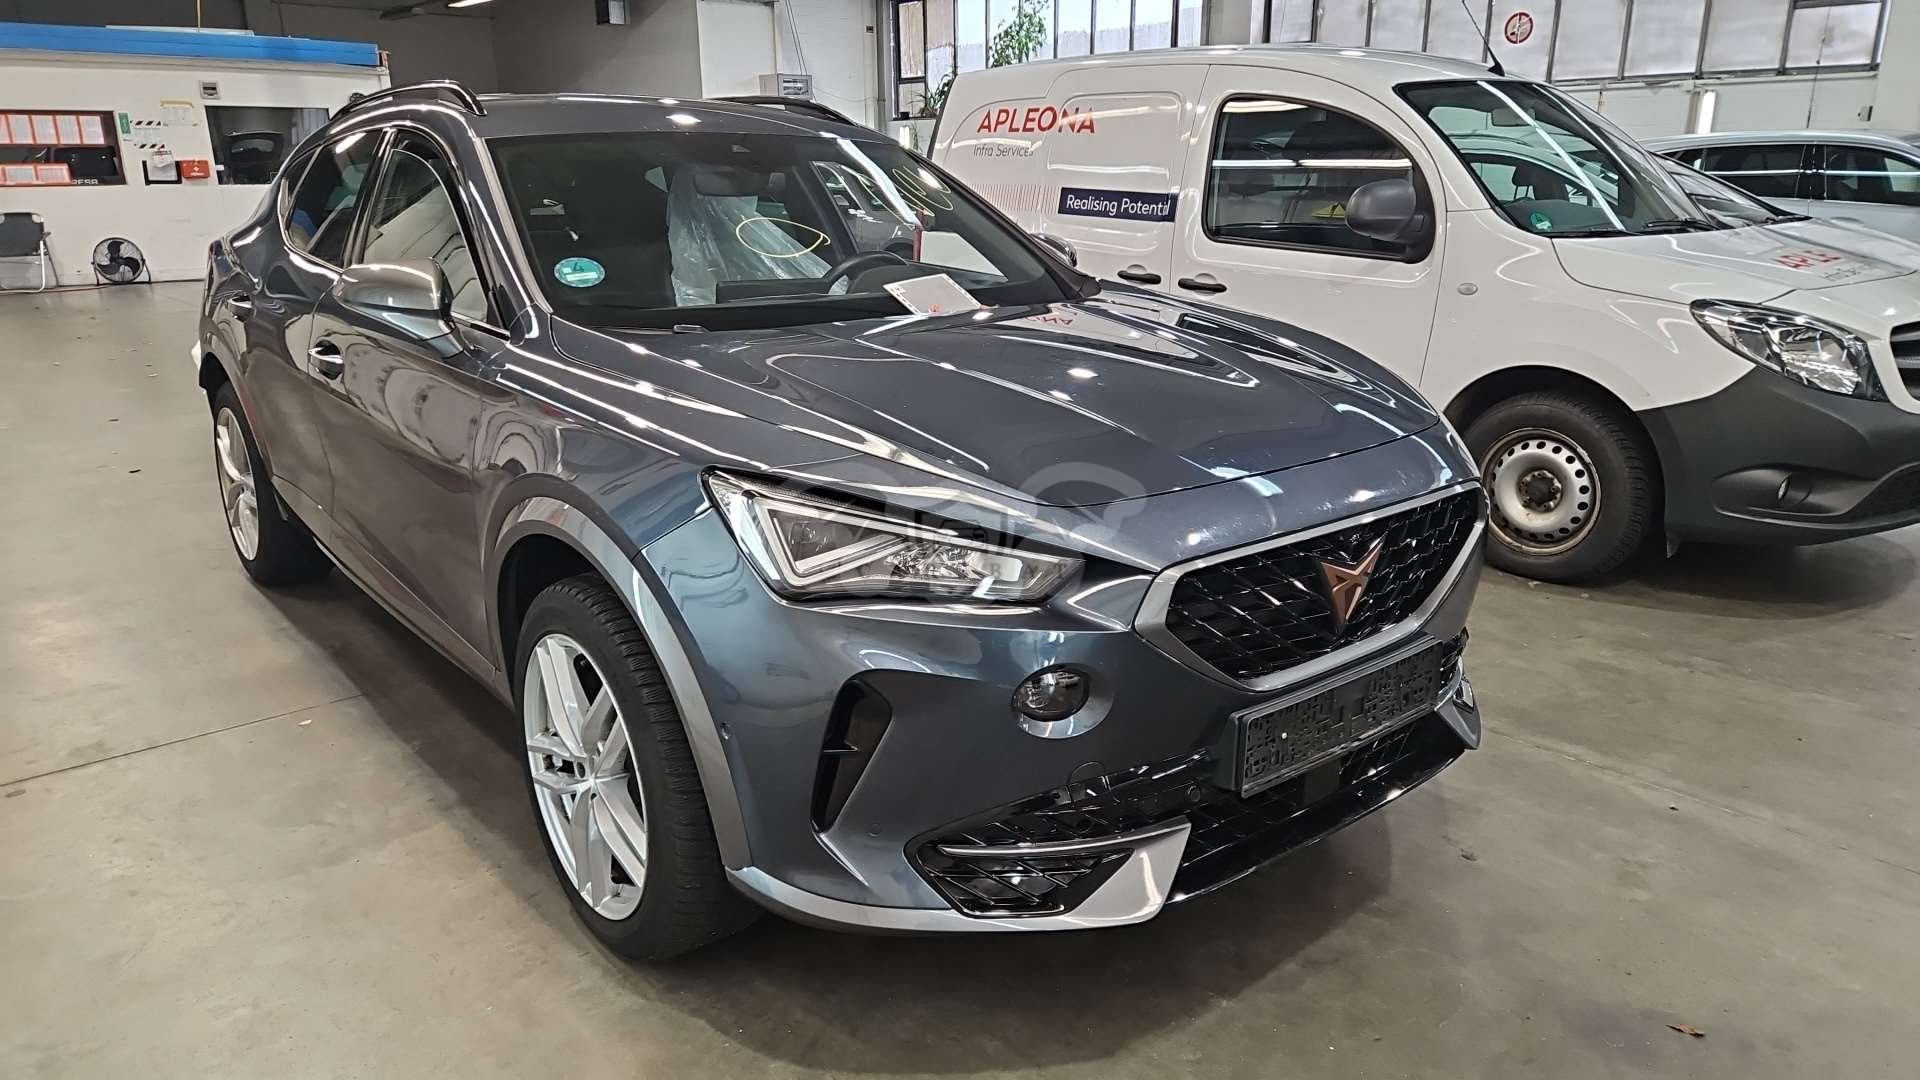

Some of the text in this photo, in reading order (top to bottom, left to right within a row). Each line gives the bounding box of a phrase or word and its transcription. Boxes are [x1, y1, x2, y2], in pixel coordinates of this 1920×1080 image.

[977, 106, 1095, 133] APLEONA
[973, 143, 993, 157] Infra
[1066, 194, 1117, 216] Realising
